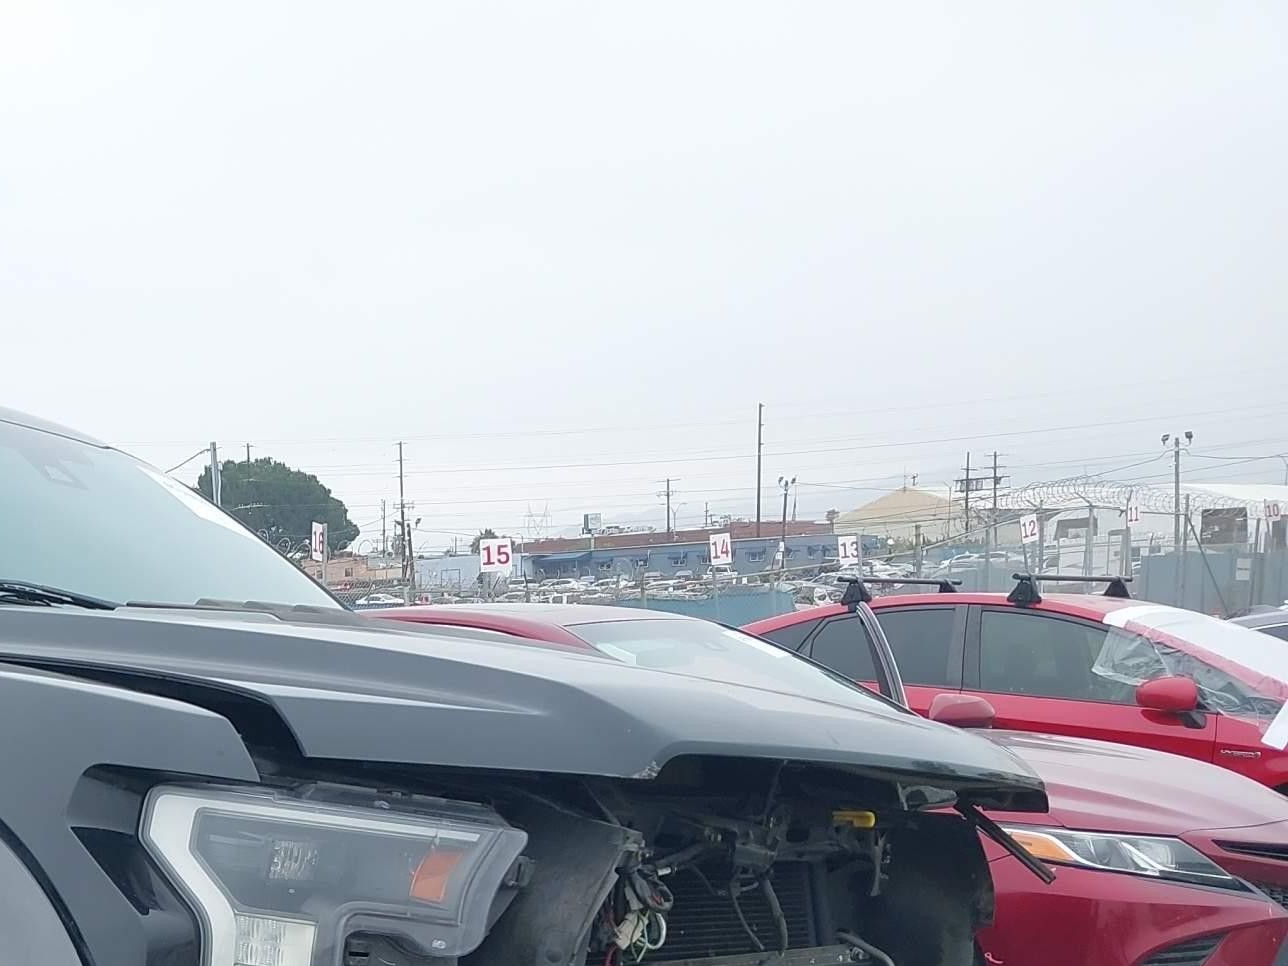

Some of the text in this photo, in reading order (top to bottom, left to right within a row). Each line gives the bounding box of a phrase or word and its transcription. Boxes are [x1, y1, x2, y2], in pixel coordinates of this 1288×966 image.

[1266, 503, 1280, 518] 10
[1022, 519, 1037, 539] 12
[482, 544, 510, 566] 15
[711, 538, 730, 560] 14
[840, 541, 859, 559] 13
